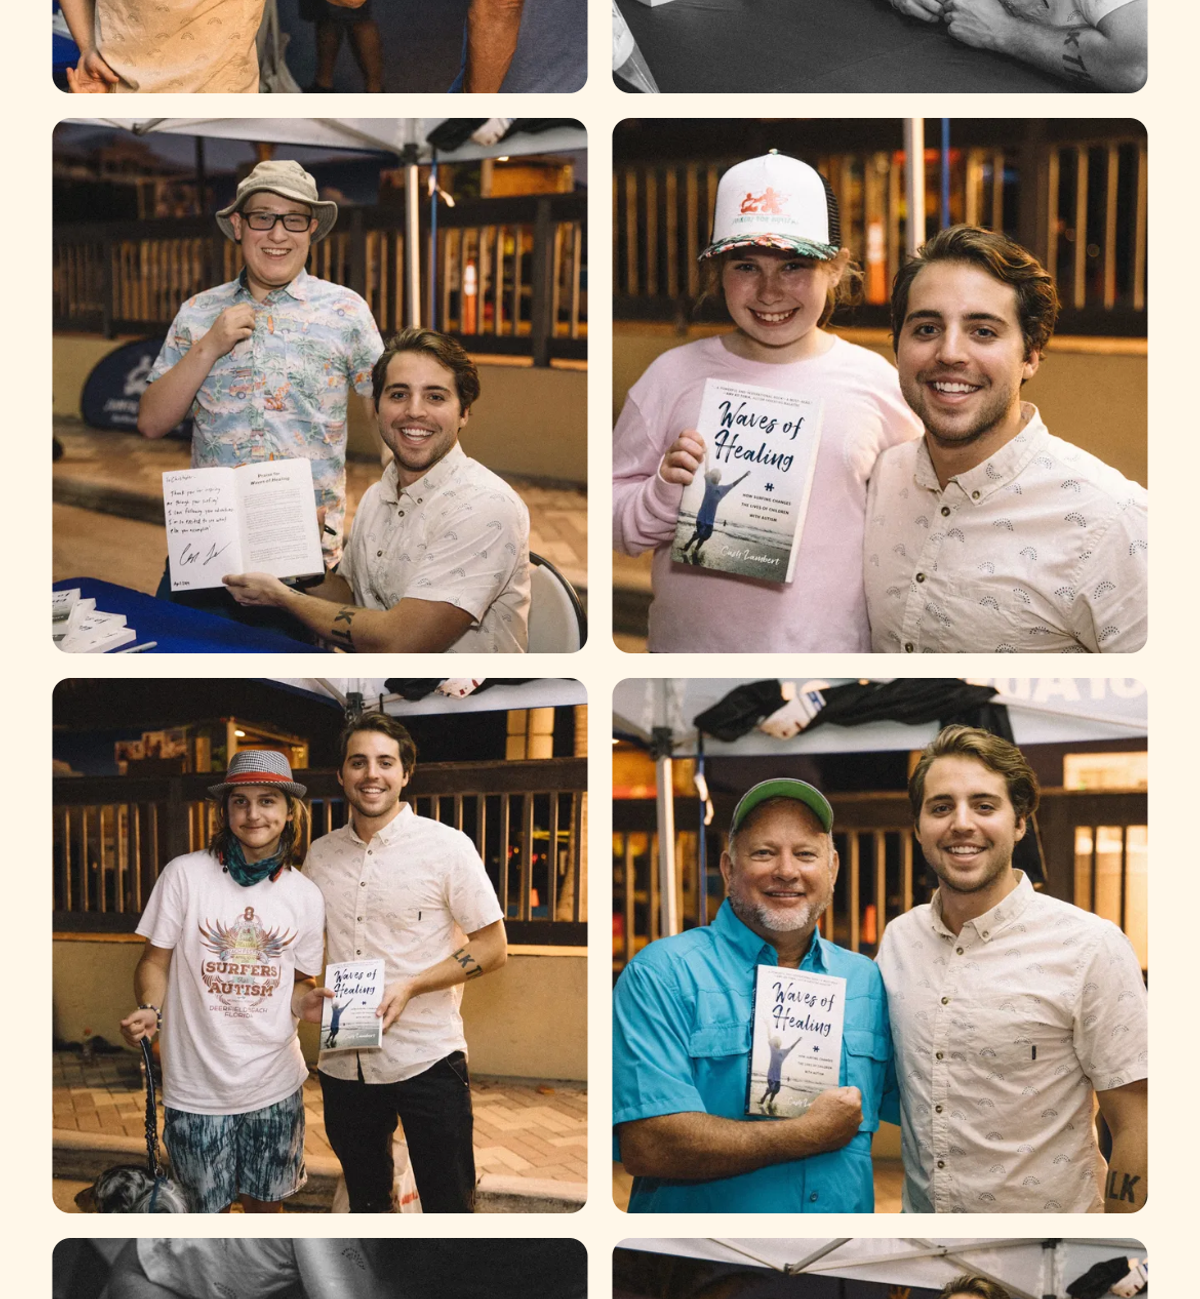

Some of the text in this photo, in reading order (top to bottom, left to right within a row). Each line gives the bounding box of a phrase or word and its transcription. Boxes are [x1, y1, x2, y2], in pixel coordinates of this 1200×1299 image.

[718, 400, 805, 441] Waves of
[714, 429, 794, 473] Healing
[244, 906, 254, 921] 8
[205, 962, 278, 977] SURFERS
[334, 968, 377, 984] Waves of
[208, 982, 273, 997] AUTISM
[333, 983, 376, 999] Healing
[772, 981, 819, 1008] Waves
[820, 994, 836, 1012] of
[772, 1004, 832, 1038] Healing
